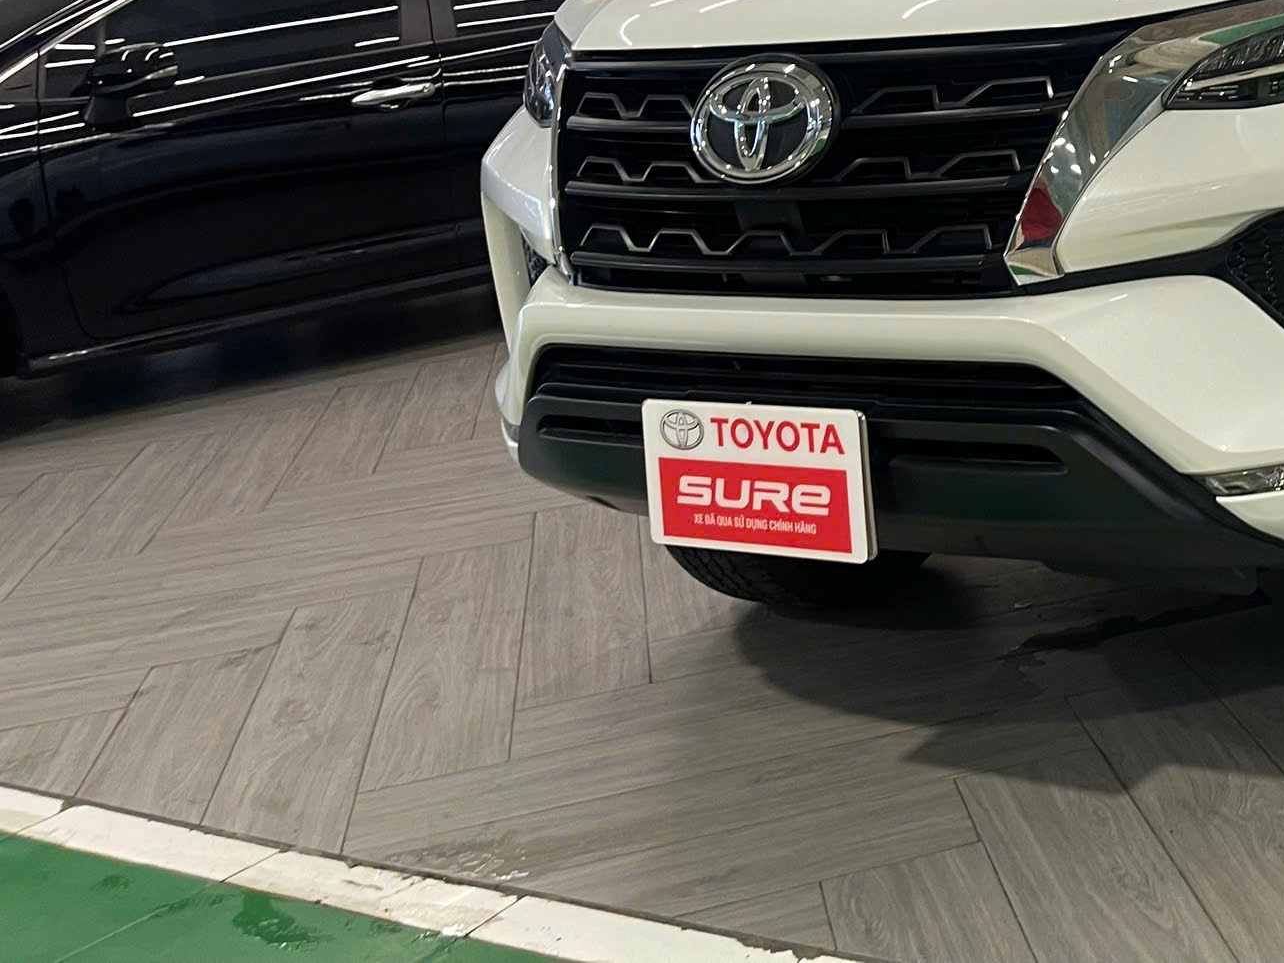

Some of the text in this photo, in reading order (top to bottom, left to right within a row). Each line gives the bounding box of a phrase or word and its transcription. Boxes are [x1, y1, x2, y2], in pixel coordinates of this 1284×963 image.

[709, 416, 846, 456] TOYOTA
[693, 513, 704, 525] XE
[716, 515, 733, 527] QUA
